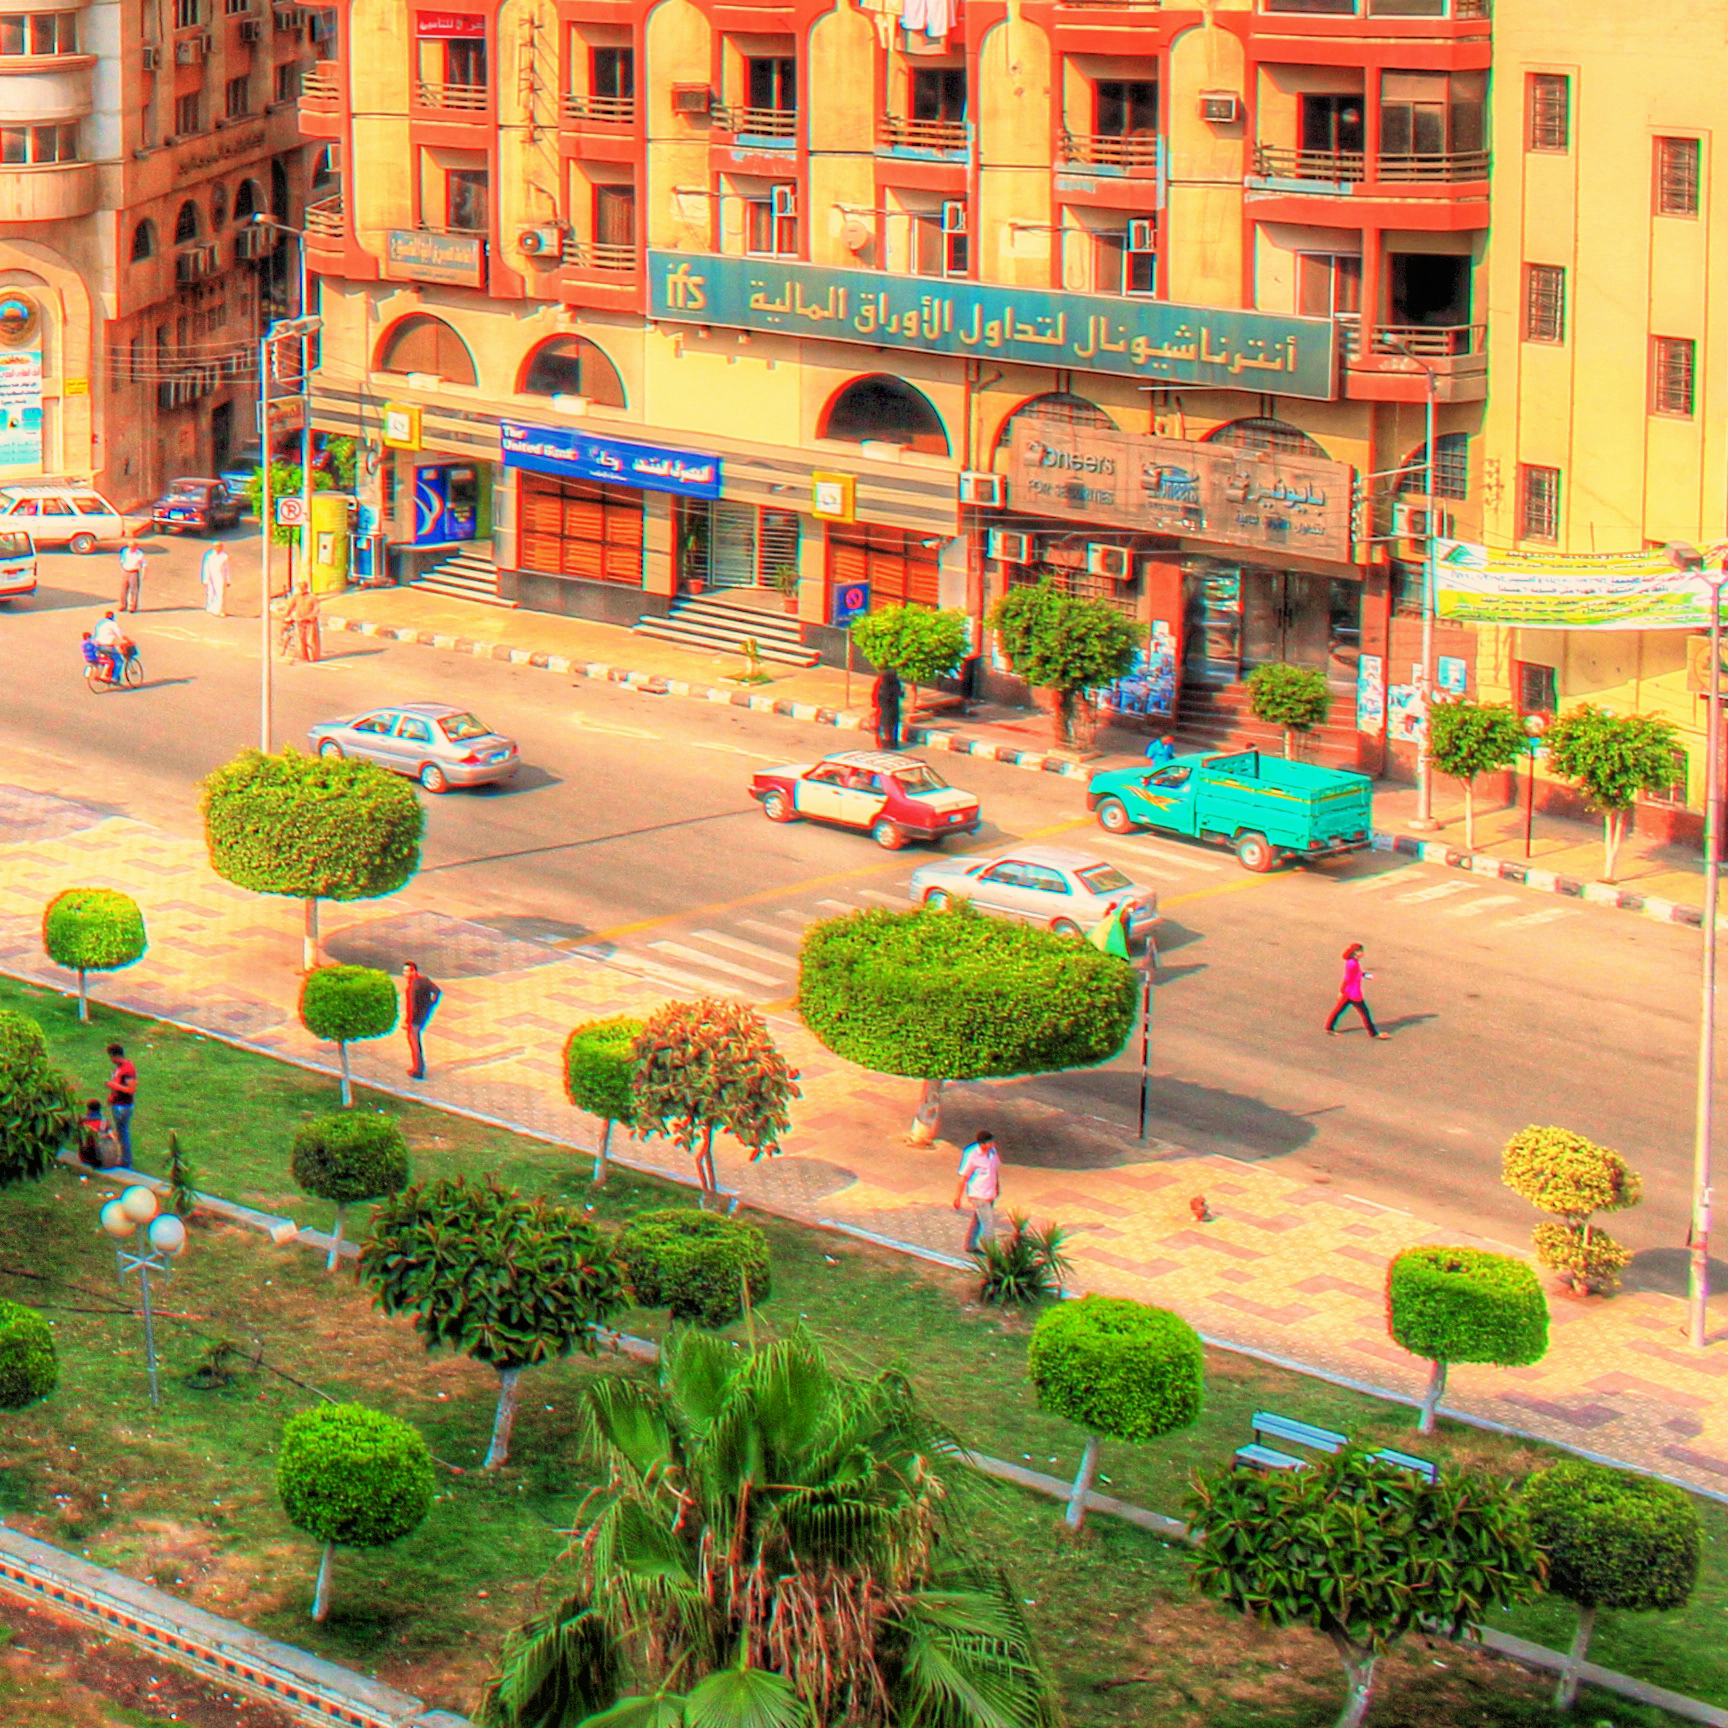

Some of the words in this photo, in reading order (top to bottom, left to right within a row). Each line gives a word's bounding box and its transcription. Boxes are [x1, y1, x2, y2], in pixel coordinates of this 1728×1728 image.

[749, 280, 847, 323] المالية
[854, 292, 954, 341] الأوراق
[959, 302, 1066, 348] لتداول
[1073, 314, 1297, 373] أنترناشيونال
[502, 425, 527, 439] The
[502, 439, 544, 456] United
